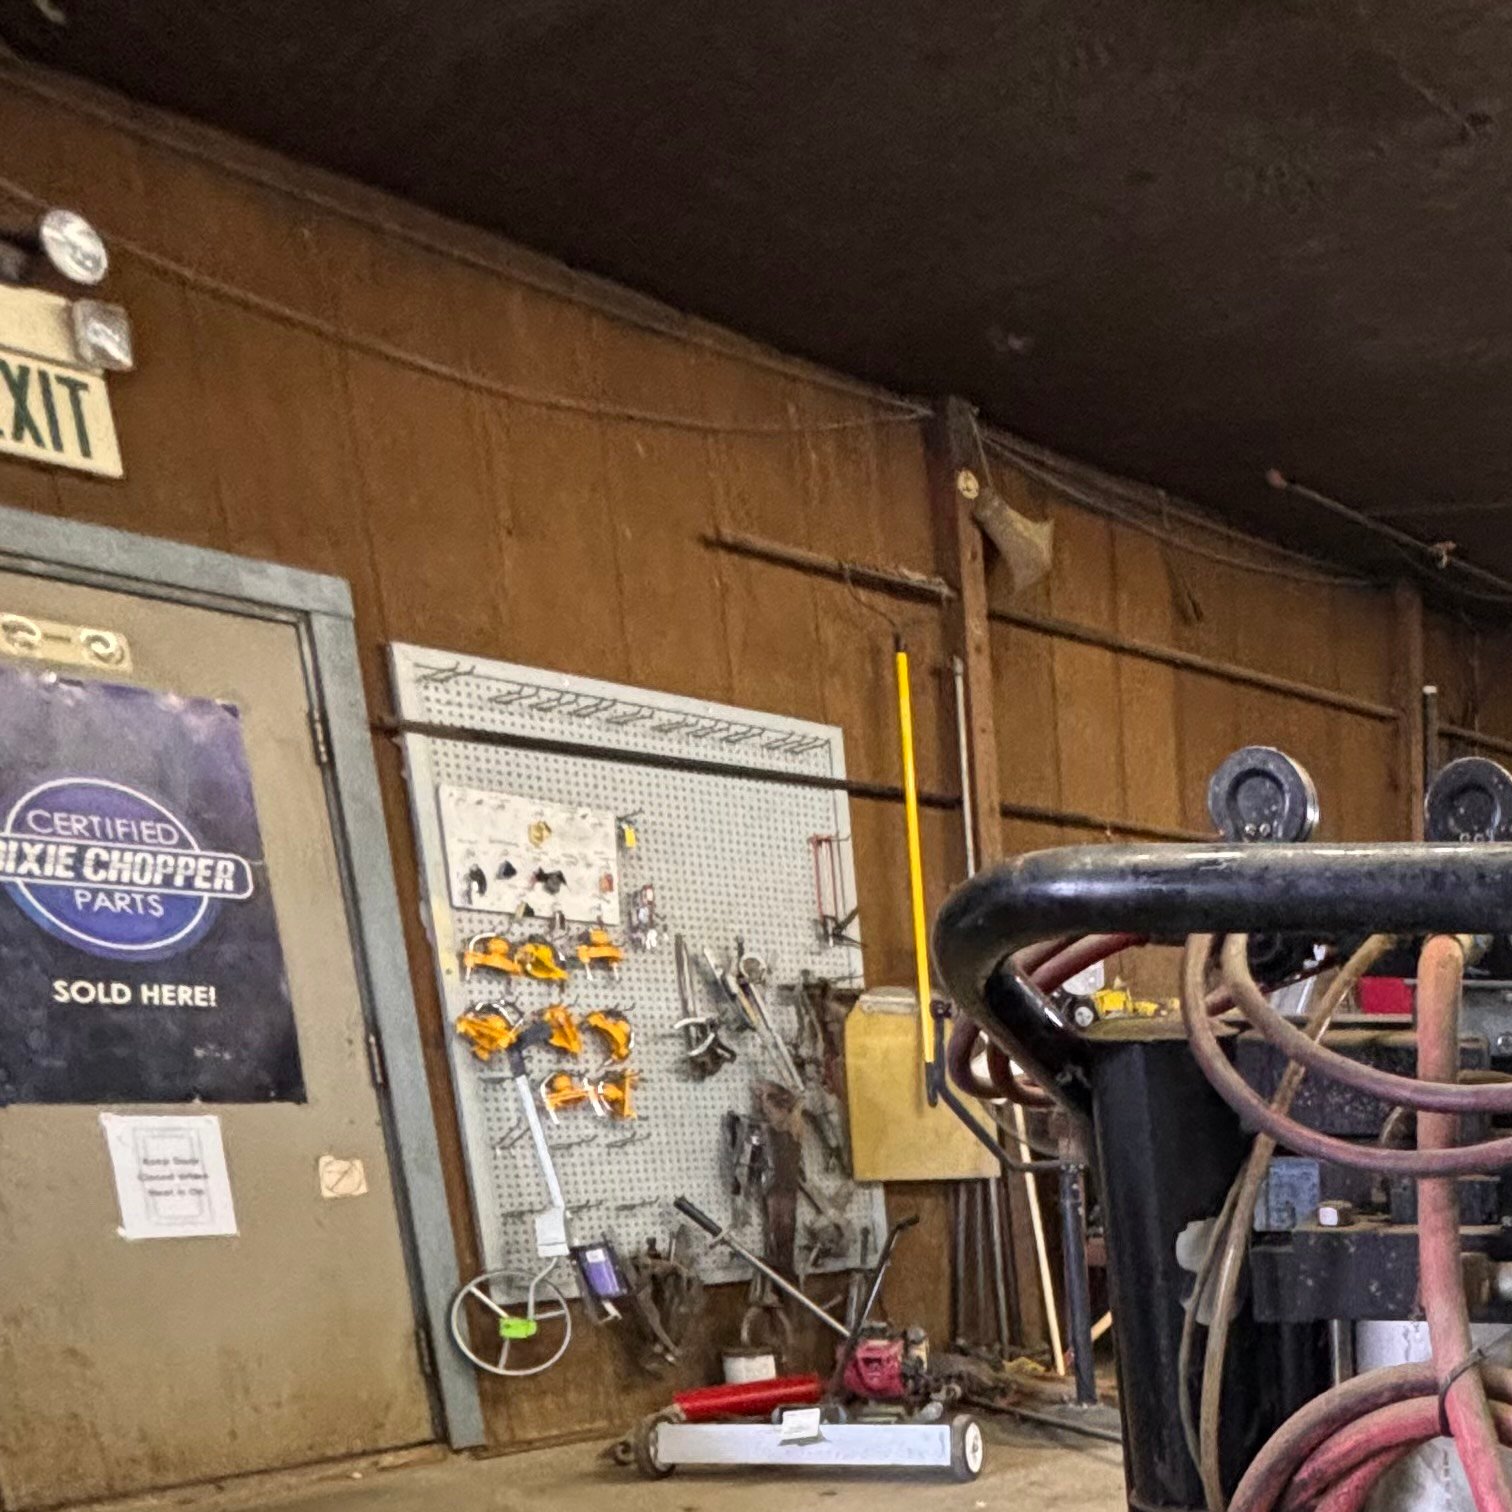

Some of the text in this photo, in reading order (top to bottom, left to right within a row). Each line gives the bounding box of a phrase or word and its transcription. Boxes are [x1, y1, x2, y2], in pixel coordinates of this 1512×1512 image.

[0, 359, 93, 459] XIT
[26, 809, 180, 846] CERTIFIED
[83, 847, 236, 892] CHOPPER
[74, 889, 165, 918] PARTS
[53, 979, 217, 1007] SOLD HERE!
